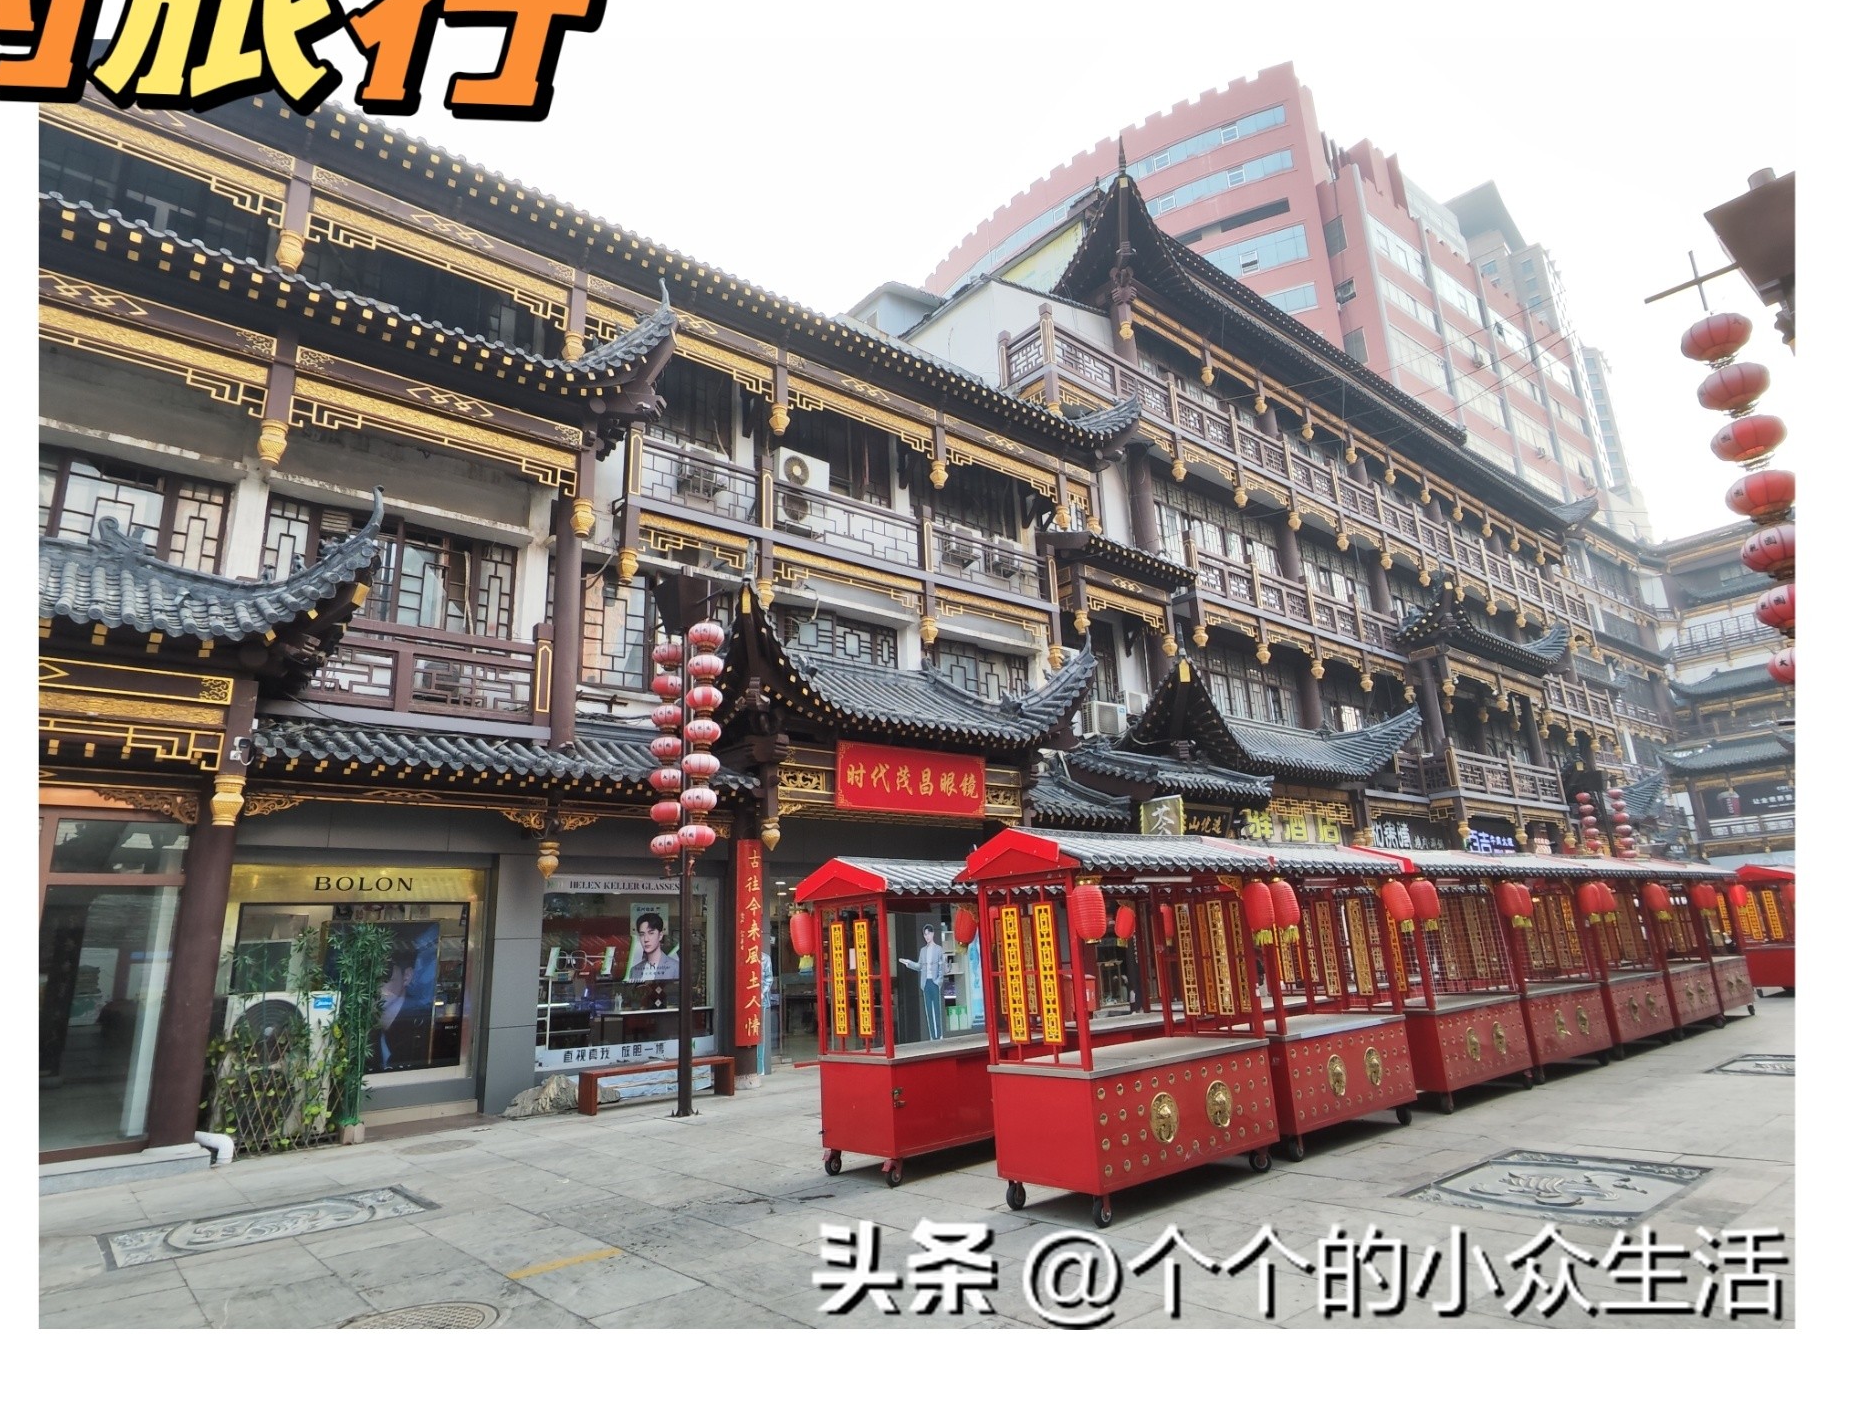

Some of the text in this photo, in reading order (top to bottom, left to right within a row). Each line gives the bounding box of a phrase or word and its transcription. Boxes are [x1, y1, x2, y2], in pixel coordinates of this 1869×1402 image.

[846, 762, 979, 799] 时代茂昌眼镜
[314, 876, 414, 892] BOLON
[569, 881, 680, 891] HELEN KELLER GLASSES
[563, 1047, 611, 1064] 直视真我
